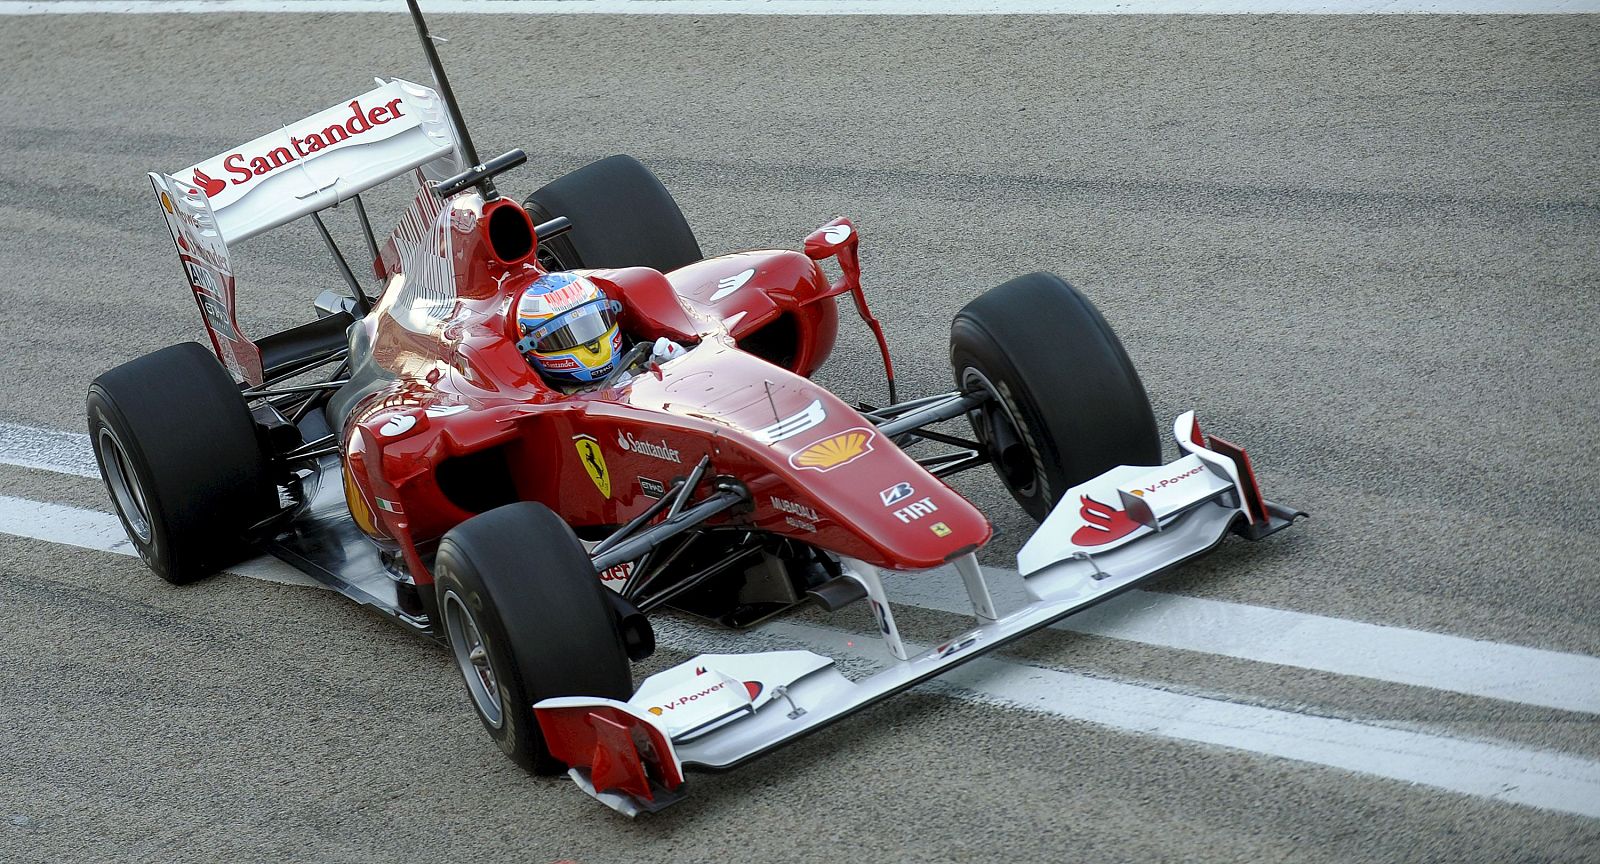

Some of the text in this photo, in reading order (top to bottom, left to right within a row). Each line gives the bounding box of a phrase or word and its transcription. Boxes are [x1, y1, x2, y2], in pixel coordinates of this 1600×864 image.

[223, 98, 406, 185] Santander
[626, 432, 682, 464] Santander
[641, 481, 664, 493] ETIHAD
[1145, 464, 1205, 493] V-Power
[770, 495, 819, 521] MUBADALA
[892, 496, 939, 524] FIAT
[663, 682, 725, 710] V-Power
